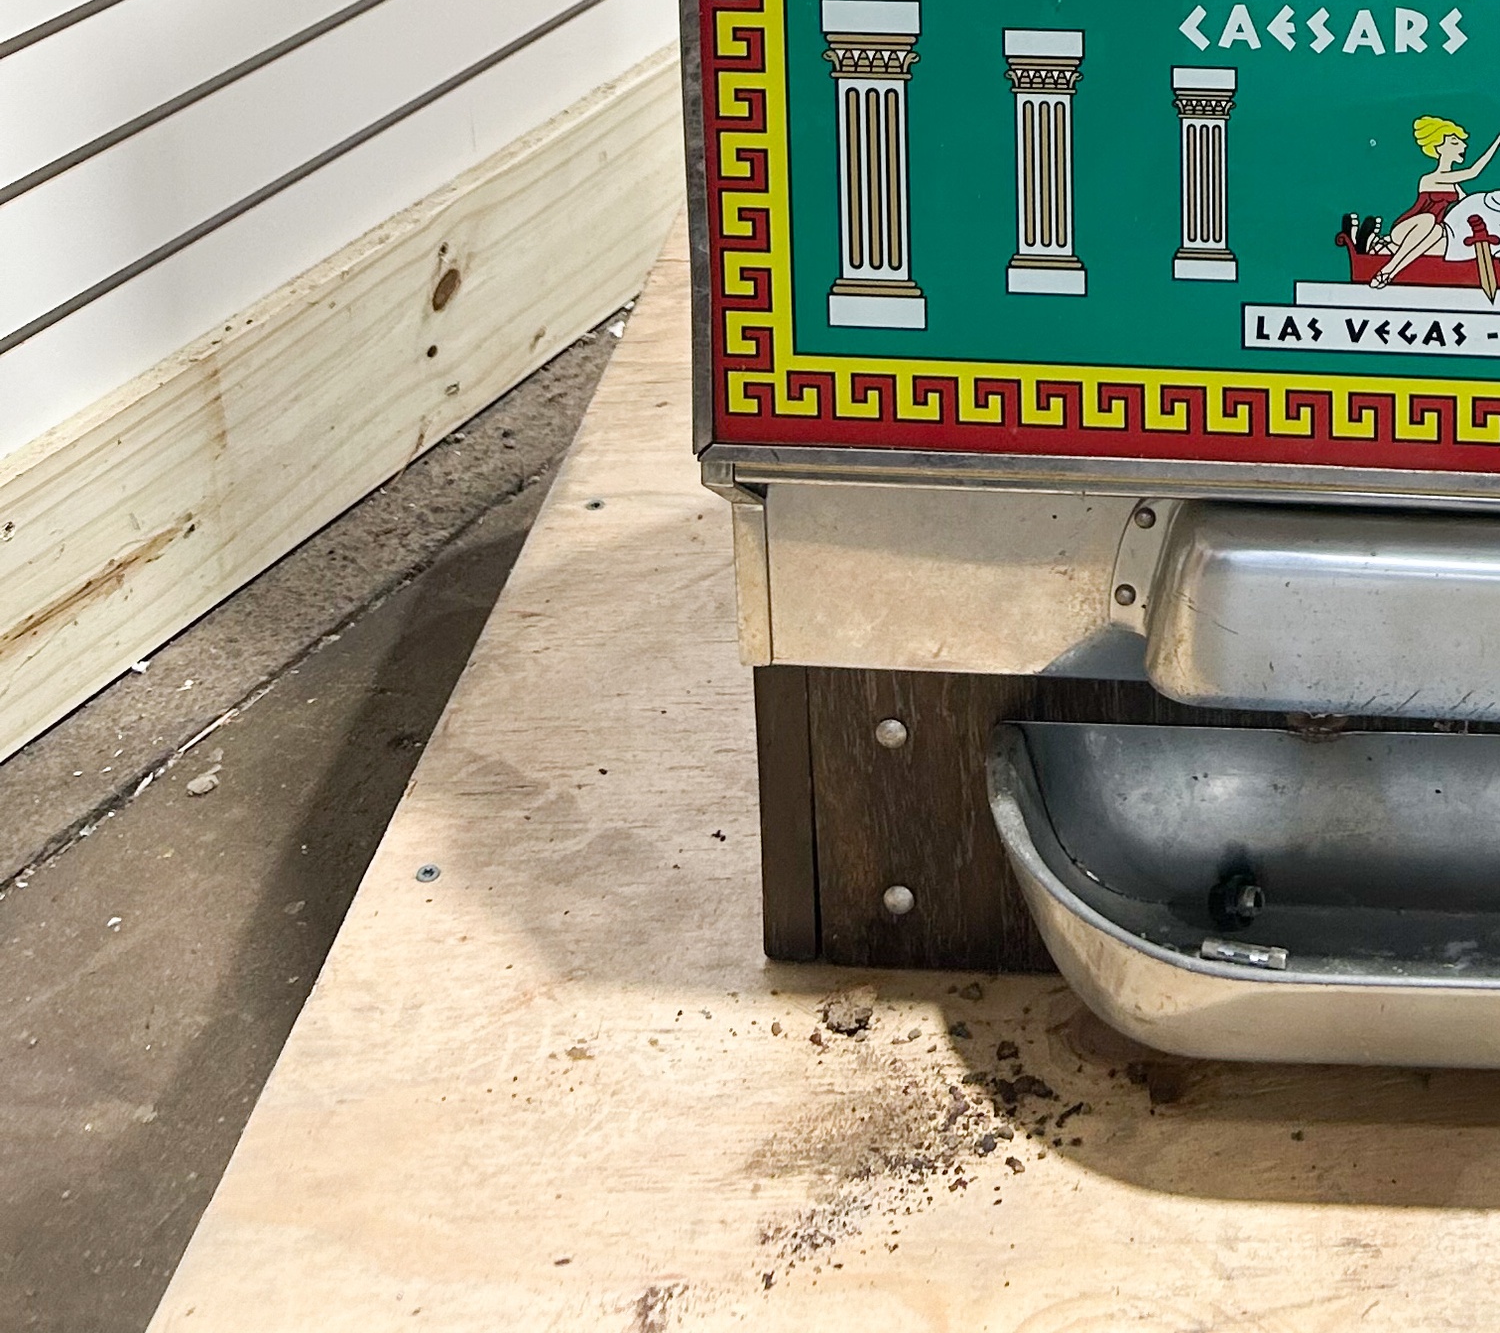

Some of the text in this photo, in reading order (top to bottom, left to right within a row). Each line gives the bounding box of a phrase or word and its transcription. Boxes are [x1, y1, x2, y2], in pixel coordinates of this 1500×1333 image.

[1178, 3, 1469, 56] CAESARS
[1255, 314, 1323, 343] LAS
[1345, 318, 1468, 348] VEGAS
